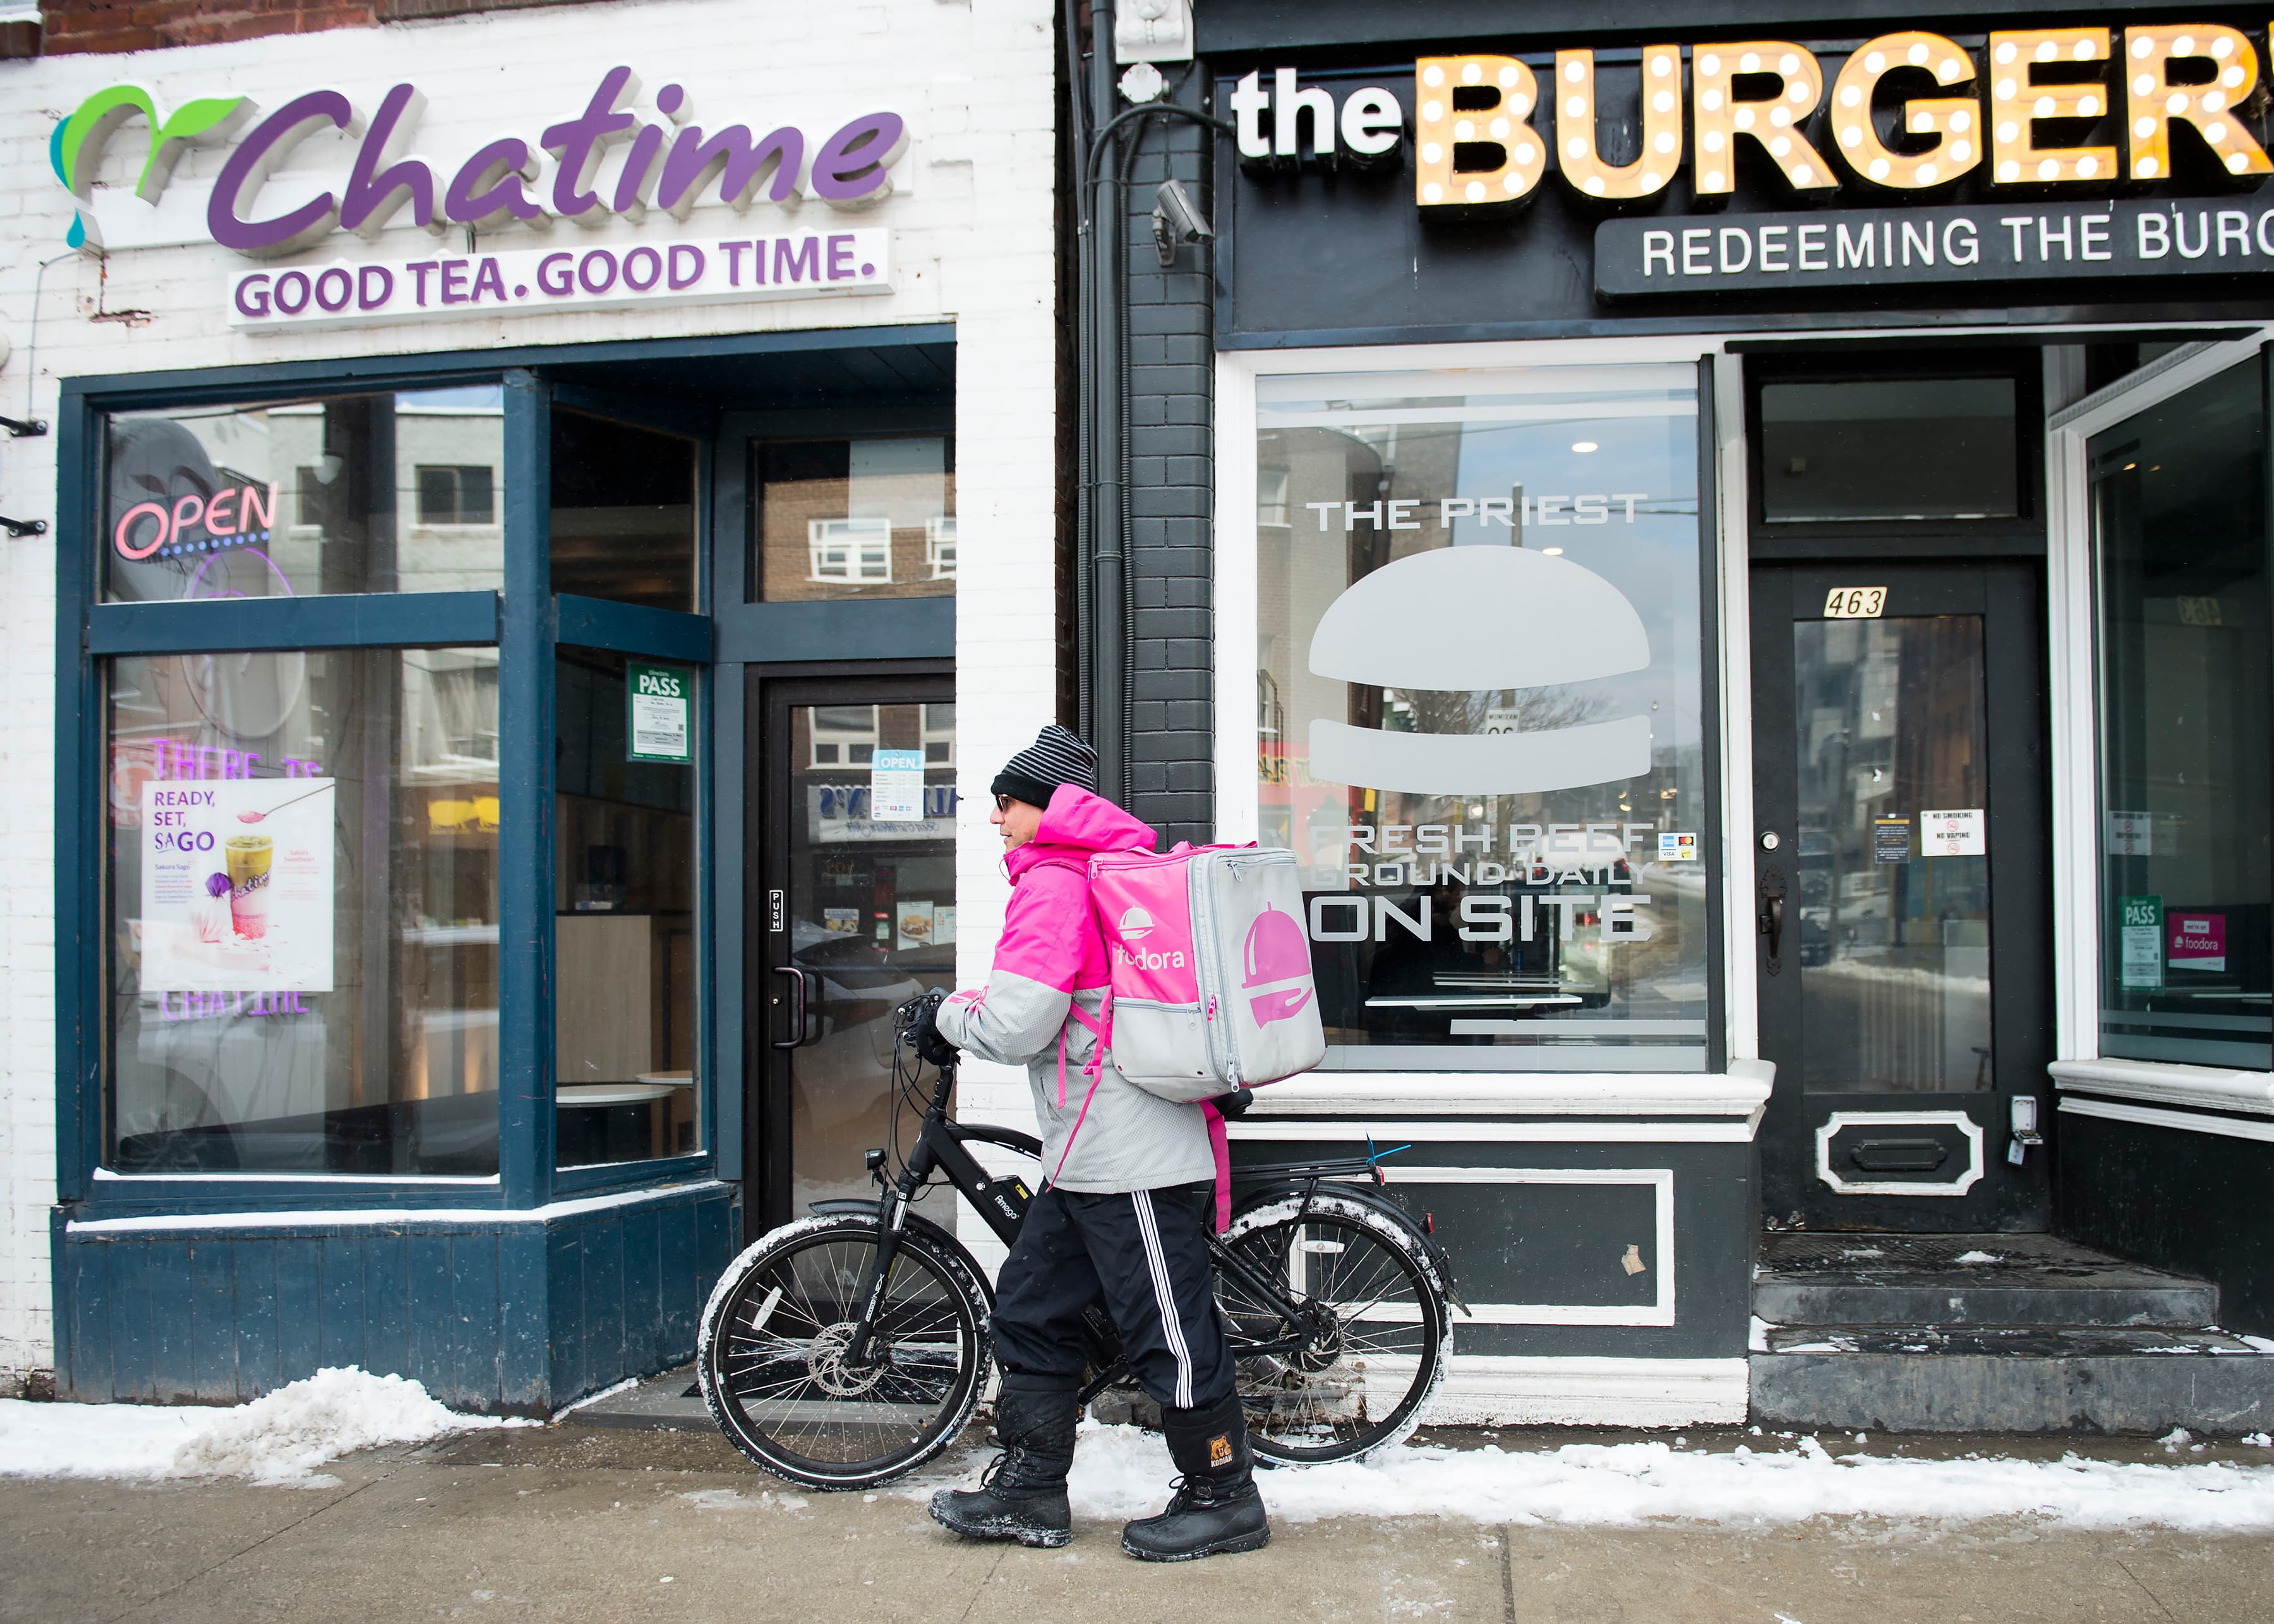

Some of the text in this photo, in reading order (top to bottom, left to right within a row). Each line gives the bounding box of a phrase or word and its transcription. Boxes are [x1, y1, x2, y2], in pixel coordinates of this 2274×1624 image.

[1230, 20, 2274, 206] the BURGER
[208, 65, 903, 249] Chatime
[1643, 219, 1980, 276] REDEEMING
[2000, 215, 2111, 263] THE
[234, 234, 875, 316] GOOD TEA. GOOD TIME.
[115, 481, 279, 560] OPEN
[1306, 493, 1648, 531] THE PRIEST
[1829, 591, 1882, 615] 463
[639, 674, 680, 697] PASS
[881, 757, 916, 769] OPEN
[154, 790, 215, 807] READY,
[153, 811, 186, 827] SET,
[154, 831, 215, 852] SAGO
[1311, 823, 1654, 853] FRESH BEEF
[1311, 862, 1654, 886] GROUND DAILY
[1309, 894, 1651, 942] ON SITE
[2126, 905, 2155, 925] PASS
[2186, 936, 2218, 950] foodora
[994, 1195, 1017, 1219] Amego
[1211, 1454, 1232, 1467] KODIAK
